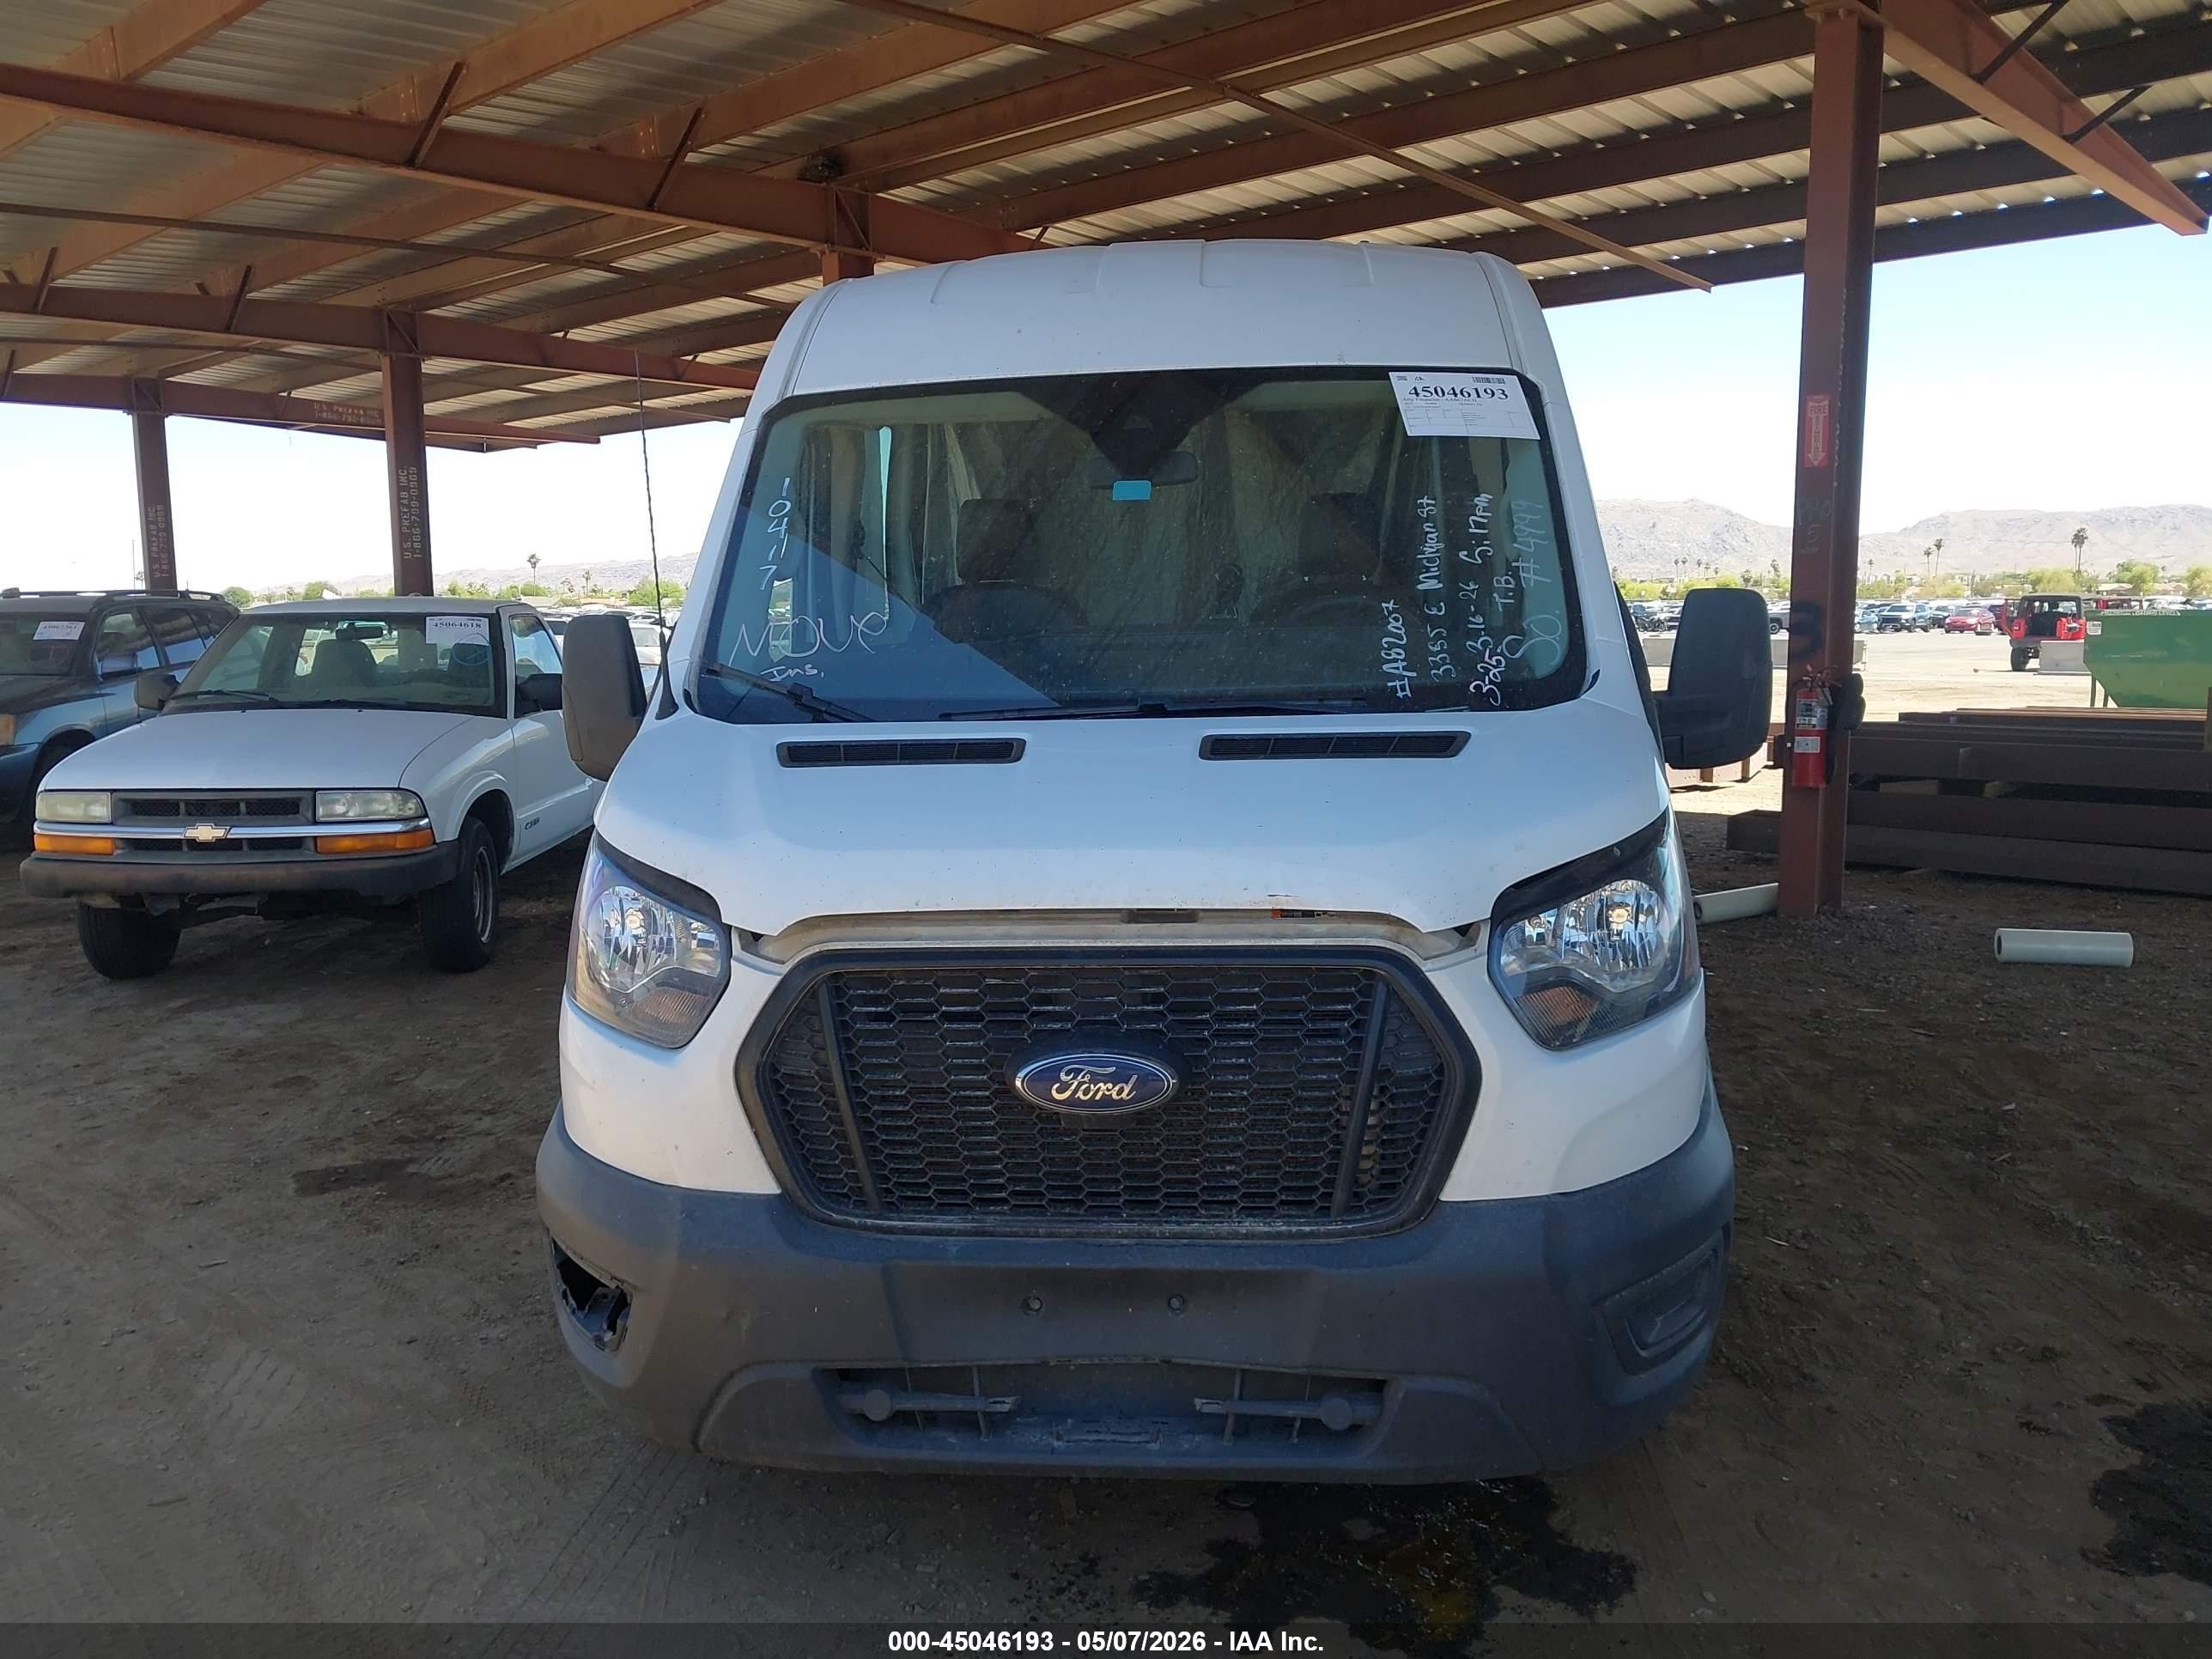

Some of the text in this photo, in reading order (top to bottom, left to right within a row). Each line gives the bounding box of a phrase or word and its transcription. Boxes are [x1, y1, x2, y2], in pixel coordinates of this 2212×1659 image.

[1408, 386, 1509, 400] 45046193
[1809, 404, 1828, 415] FIRE
[398, 465, 412, 559] U.S. PREFAB INC.
[1424, 602, 1446, 616] E
[1050, 1064, 1139, 1101] Ford
